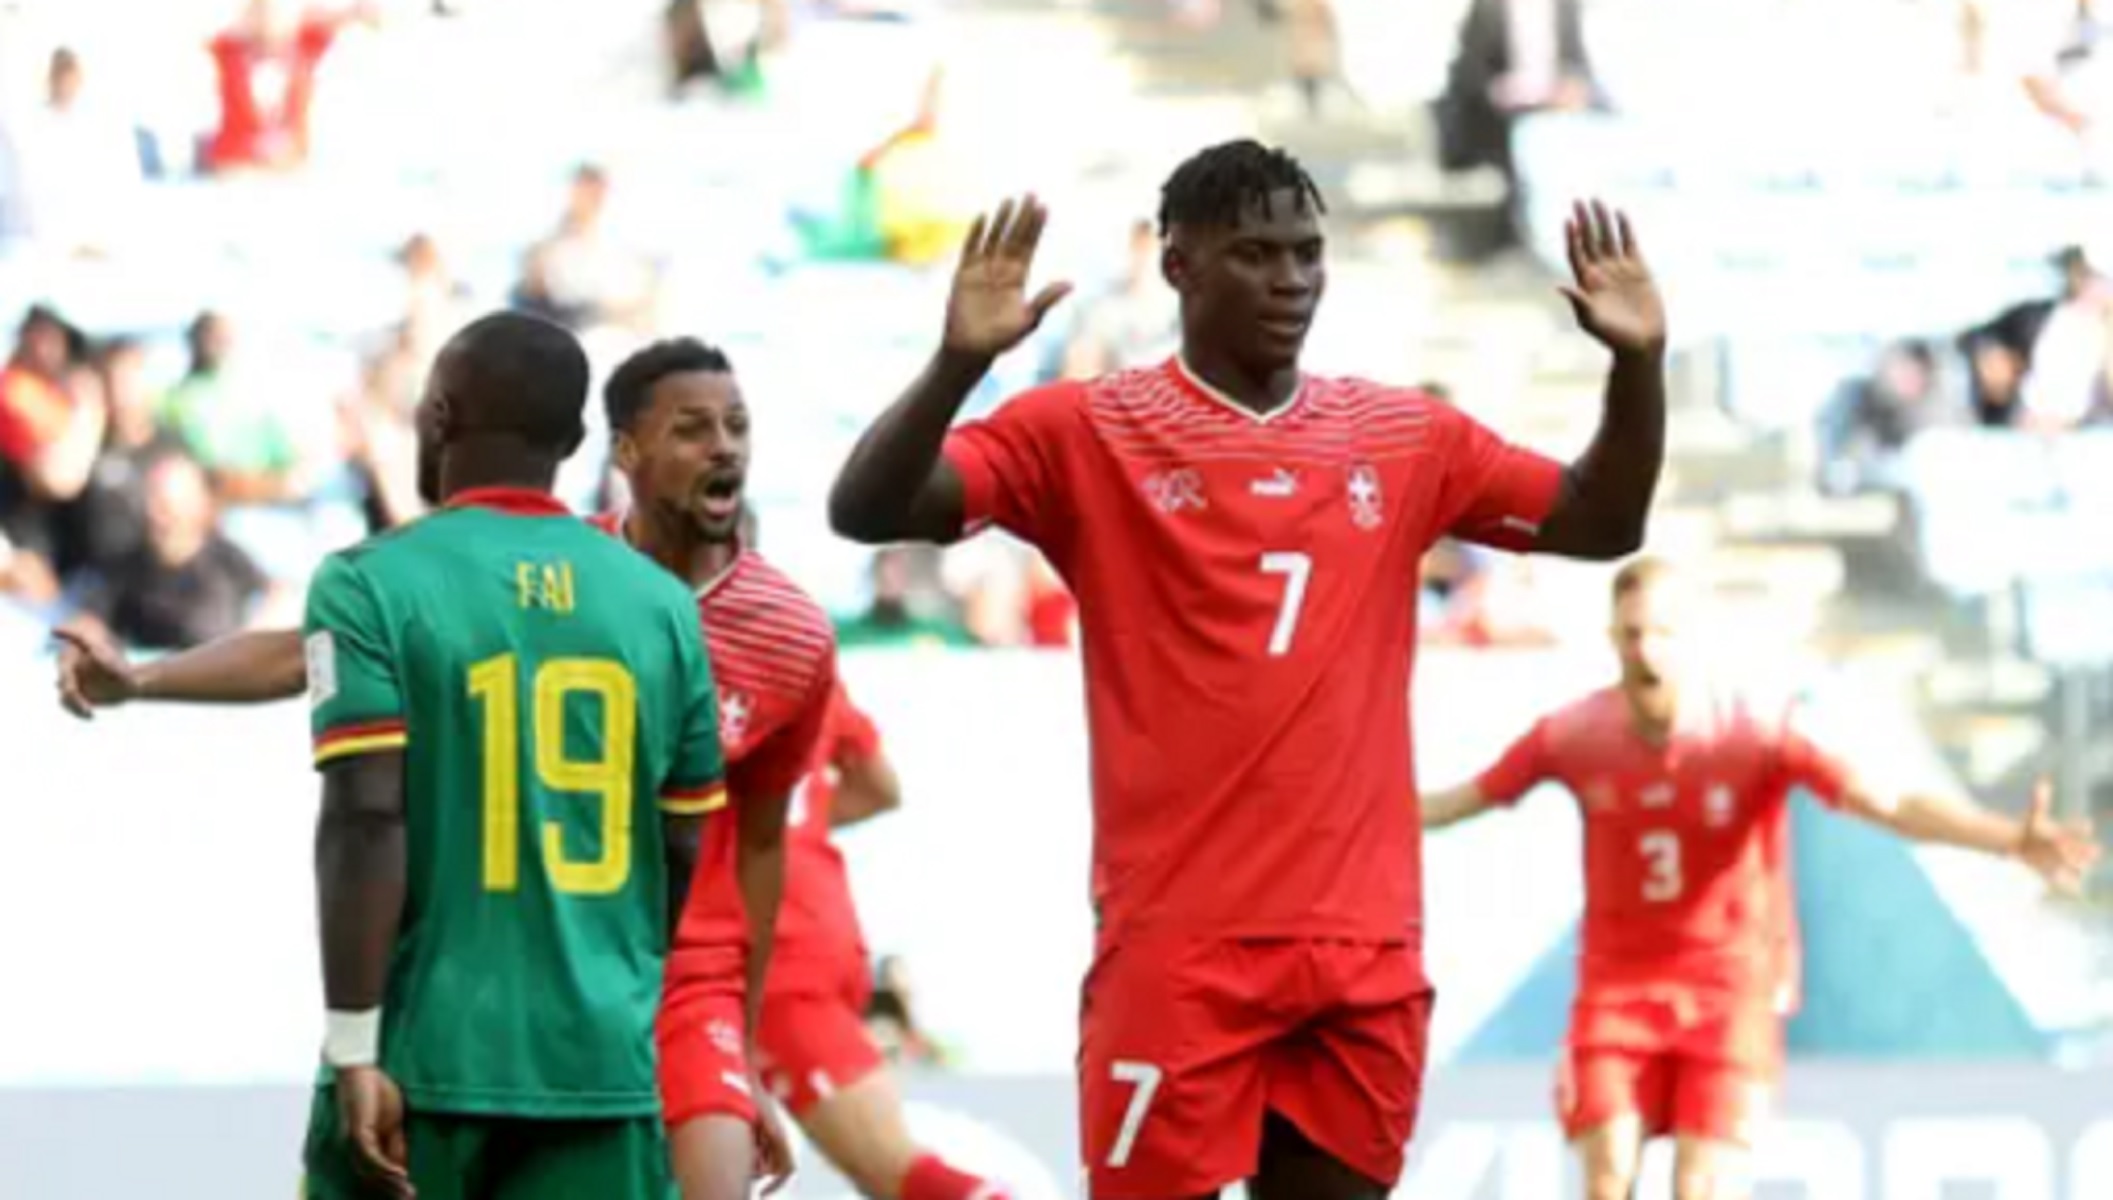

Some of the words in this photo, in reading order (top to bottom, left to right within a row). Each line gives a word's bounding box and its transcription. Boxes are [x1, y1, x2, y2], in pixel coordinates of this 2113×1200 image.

[517, 561, 575, 615] FAI
[1260, 551, 1311, 655] 7
[467, 653, 637, 893] 19
[1639, 830, 1682, 901] 3
[1107, 1060, 1163, 1168] 7
